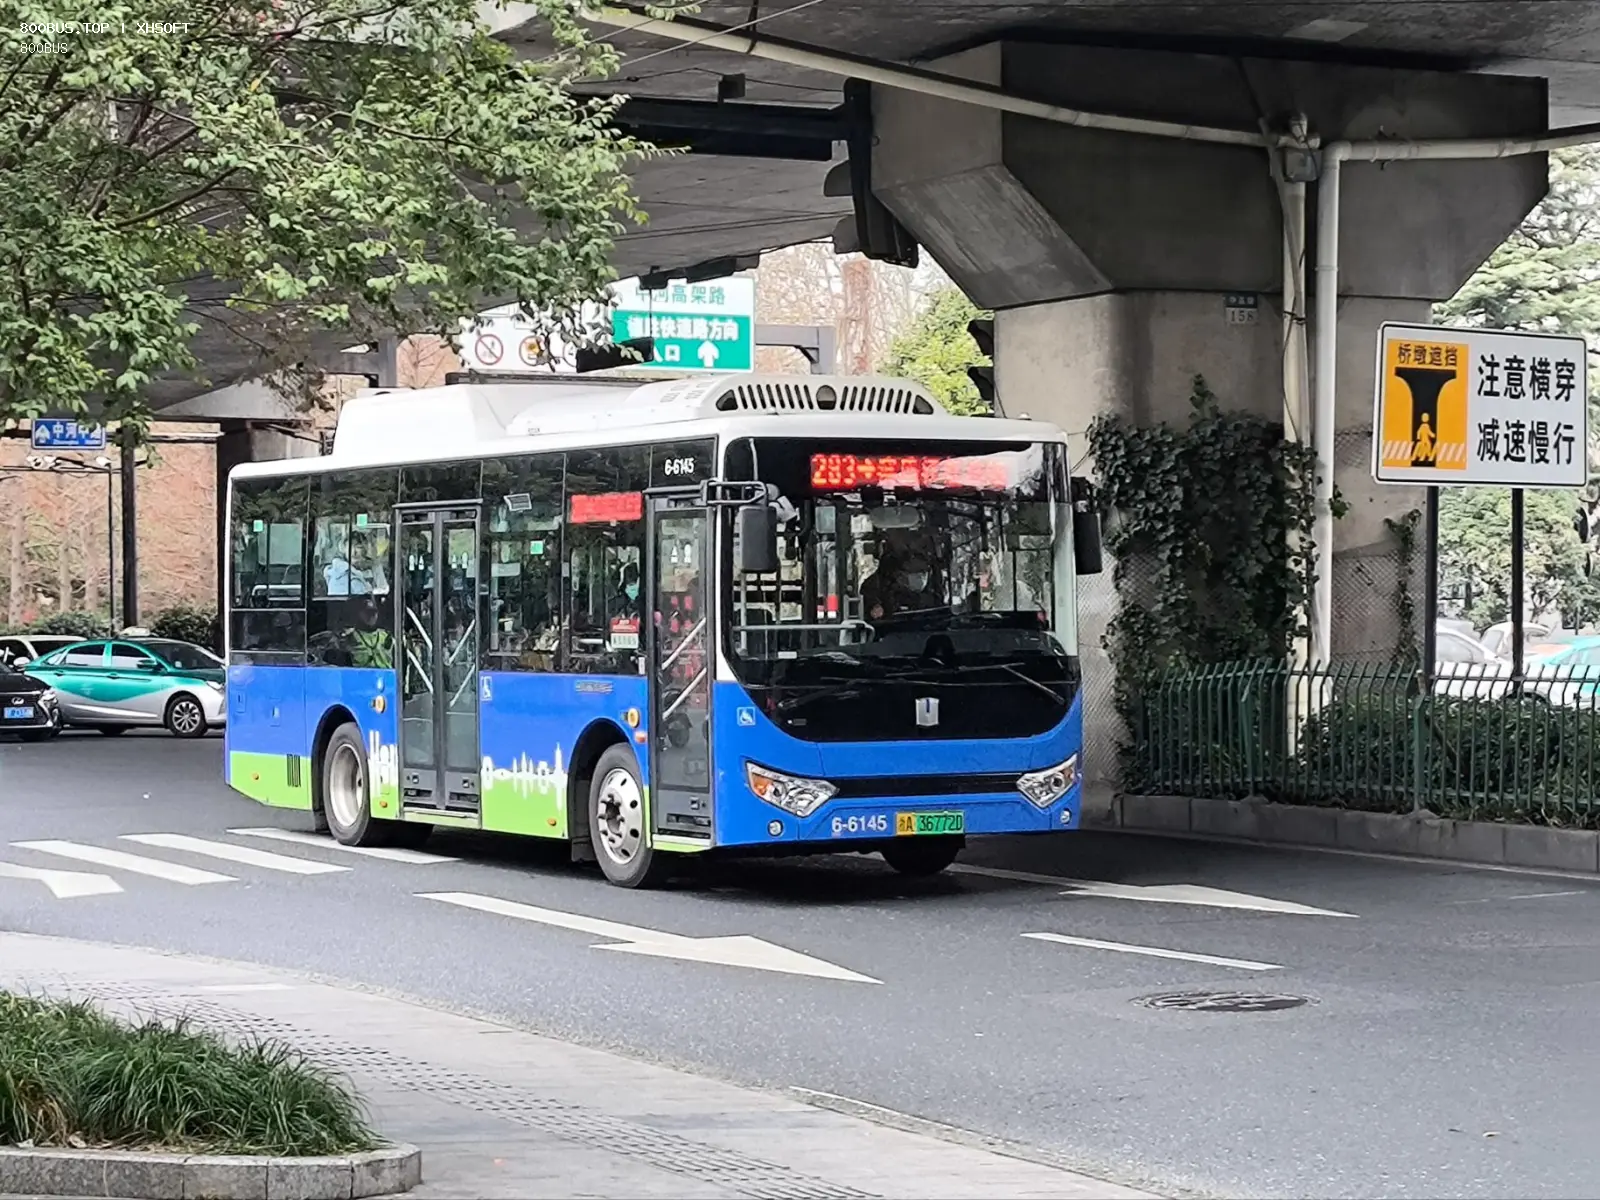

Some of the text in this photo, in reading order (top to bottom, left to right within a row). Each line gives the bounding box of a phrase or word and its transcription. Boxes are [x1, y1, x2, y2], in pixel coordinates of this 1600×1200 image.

[1398, 343, 1457, 366] 桥墩遮挡
[1477, 354, 1576, 402] 注意横穿
[1477, 418, 1575, 465] 减速慢行
[664, 457, 695, 476] 6-6145
[831, 815, 887, 833] 6-6145
